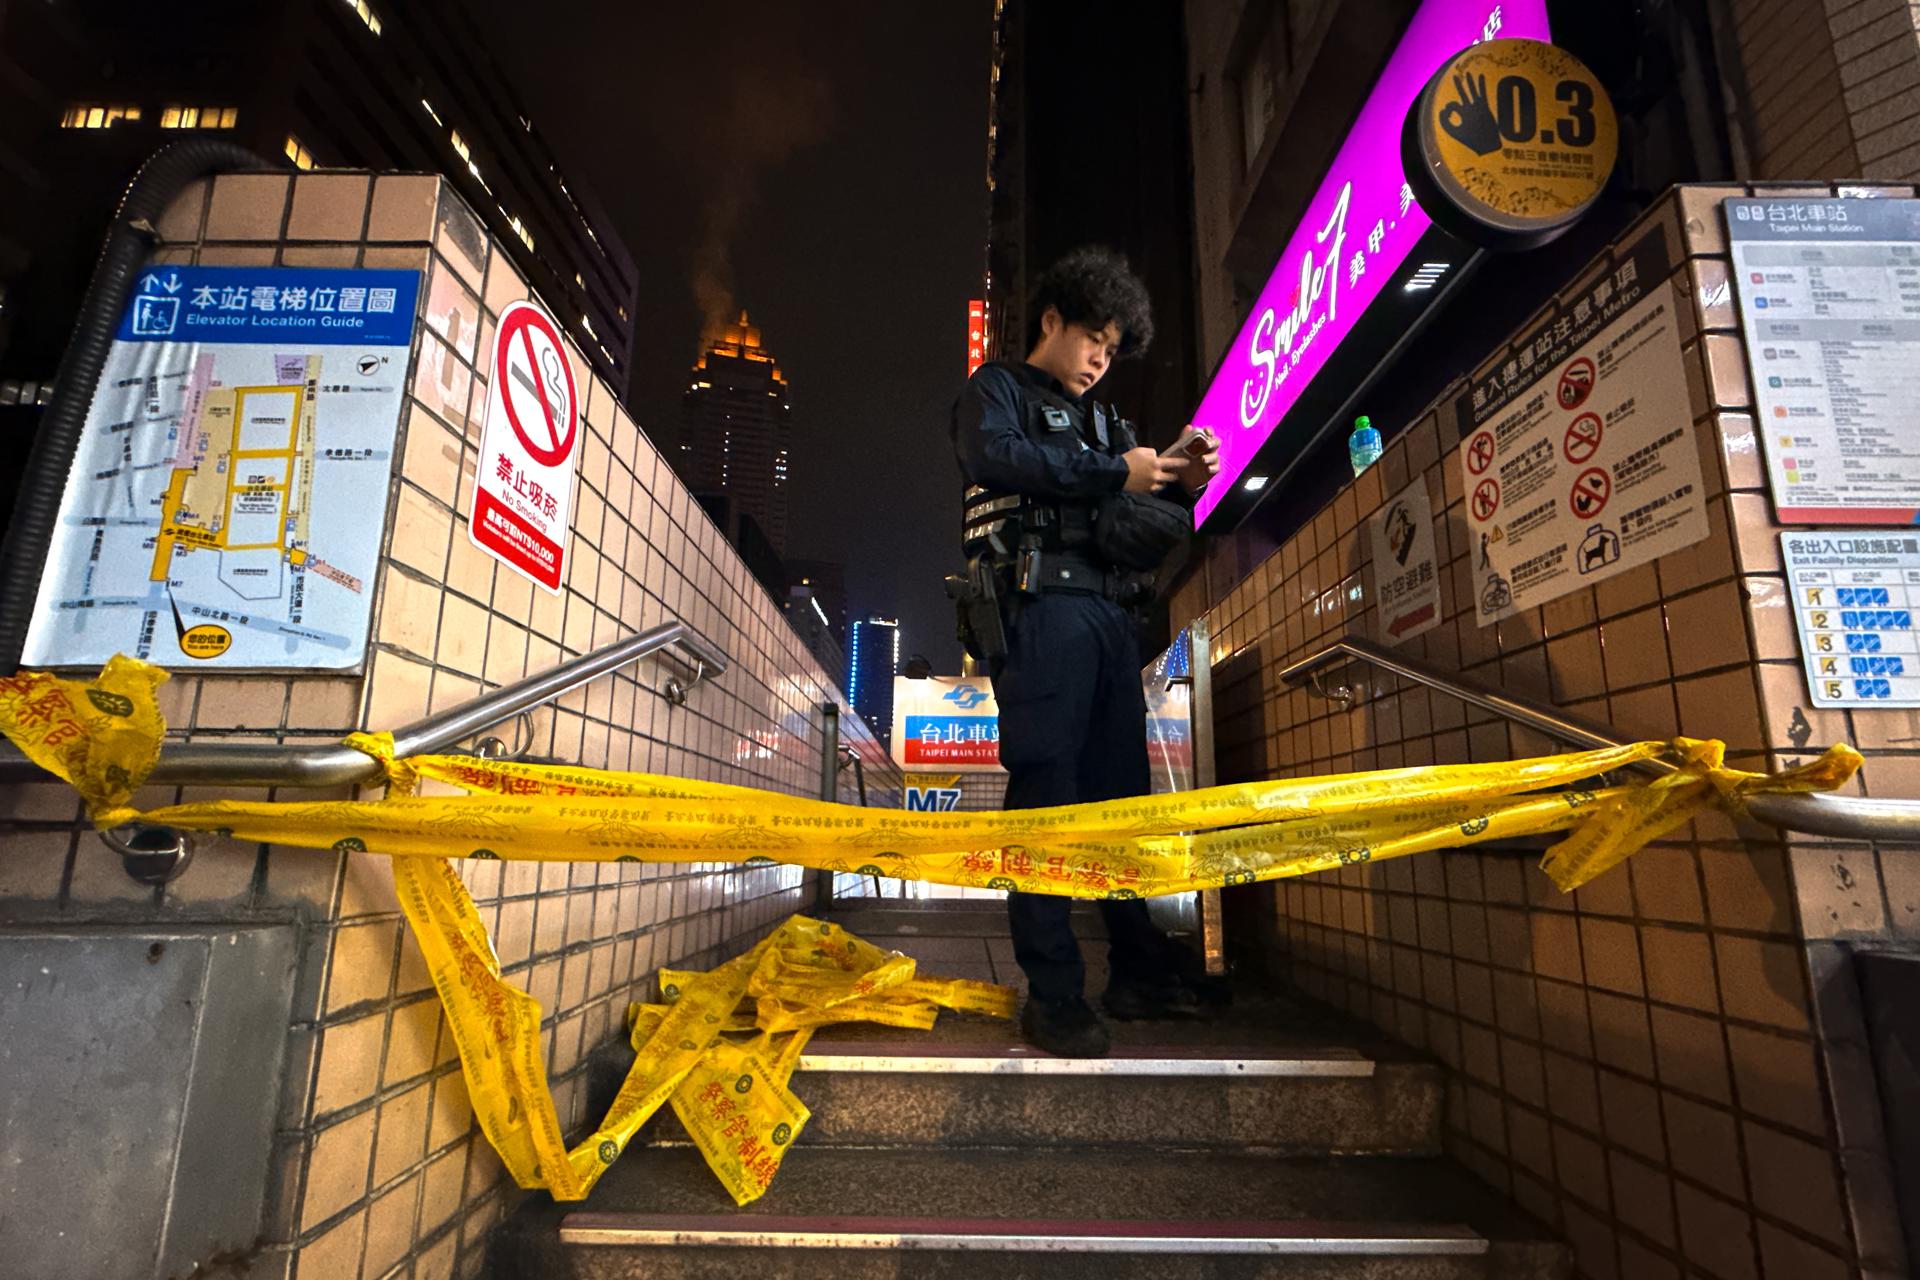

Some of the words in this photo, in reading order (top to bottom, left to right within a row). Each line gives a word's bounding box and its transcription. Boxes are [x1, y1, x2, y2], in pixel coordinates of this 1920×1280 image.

[1497, 75, 1597, 148] 0.3
[1767, 204, 1848, 221] 台北車站
[1769, 223, 1799, 233] Taipei
[1801, 223, 1826, 232] Main
[1828, 223, 1864, 232] Station
[190, 285, 397, 313] 本站電梯位置圖
[186, 313, 247, 326] Elevator
[252, 315, 315, 328] Location
[321, 317, 364, 328] Guide
[1472, 257, 1638, 411] 進入捷運站注意事項
[1474, 393, 1506, 422] General
[1508, 373, 1533, 396] Rules
[1534, 360, 1548, 380] for
[1550, 345, 1568, 363] the
[1570, 316, 1601, 346] Taipei
[1603, 286, 1641, 319] Metro
[496, 452, 558, 522] 禁止吸菸
[502, 489, 513, 505] No
[515, 500, 547, 533] Smoking
[1789, 539, 1918, 554] 各出入口設施配置
[1792, 556, 1810, 564] Exit
[1812, 556, 1844, 565] Facility
[1847, 556, 1898, 565] Disposition
[1812, 591, 1821, 605] 1
[191, 606, 249, 625] 中山北路一段
[1817, 614, 1829, 628] 2
[1821, 637, 1832, 651] 3
[1825, 660, 1837, 675] 4
[1830, 684, 1842, 698] 5
[920, 749, 948, 757] TAIPEI
[951, 749, 973, 757] MAIN
[907, 787, 961, 812] M7
[700, 1081, 780, 1189] 警察管制線
